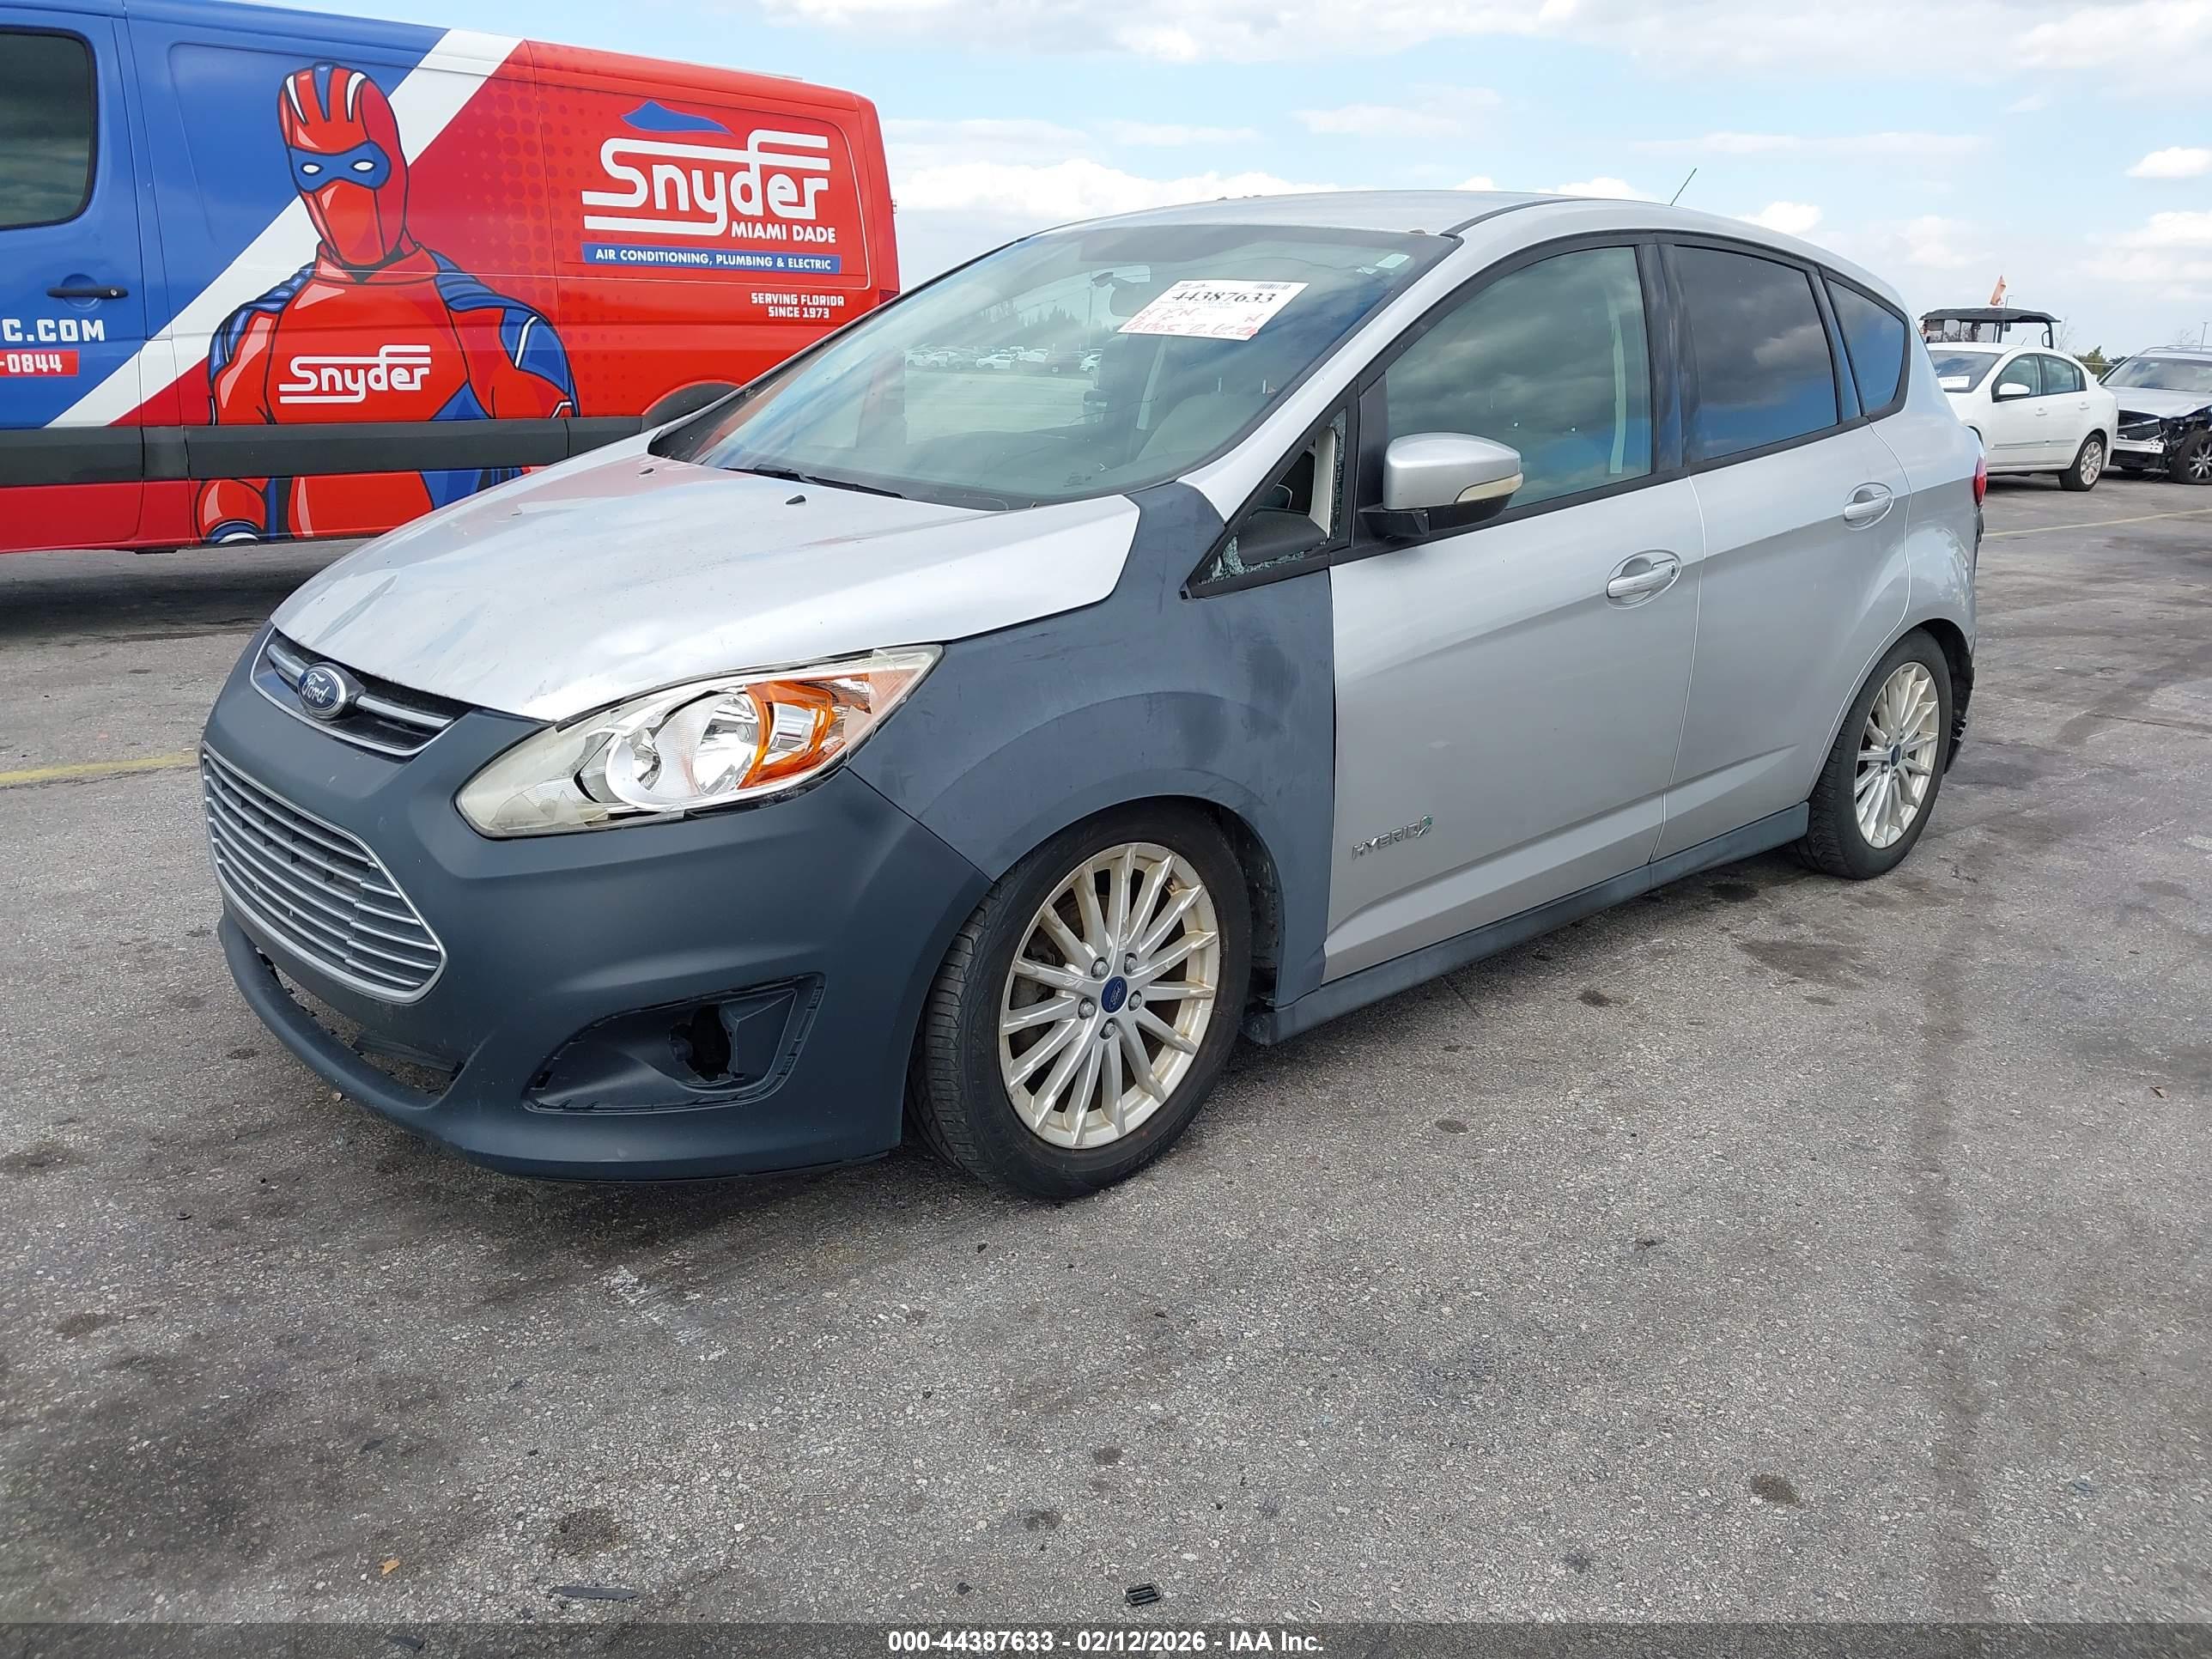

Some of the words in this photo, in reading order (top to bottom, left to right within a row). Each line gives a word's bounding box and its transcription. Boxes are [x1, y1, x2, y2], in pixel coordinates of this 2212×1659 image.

[581, 129, 830, 236] Snyder
[731, 221, 787, 240] MIAMI
[793, 226, 836, 244] DADE
[595, 248, 617, 261] AIR
[620, 249, 714, 267] CONDITIONING,
[715, 254, 773, 268] PLUMBING
[776, 259, 785, 269] &
[787, 259, 831, 270] ELECTRIC
[750, 292, 799, 306] SERVING
[800, 295, 845, 307] FLORIDA
[1172, 290, 1277, 304] 44387633
[768, 306, 801, 318] SINCE
[802, 307, 830, 319] 1973
[279, 344, 431, 404] Snyder
[301, 672, 331, 704] Ford
